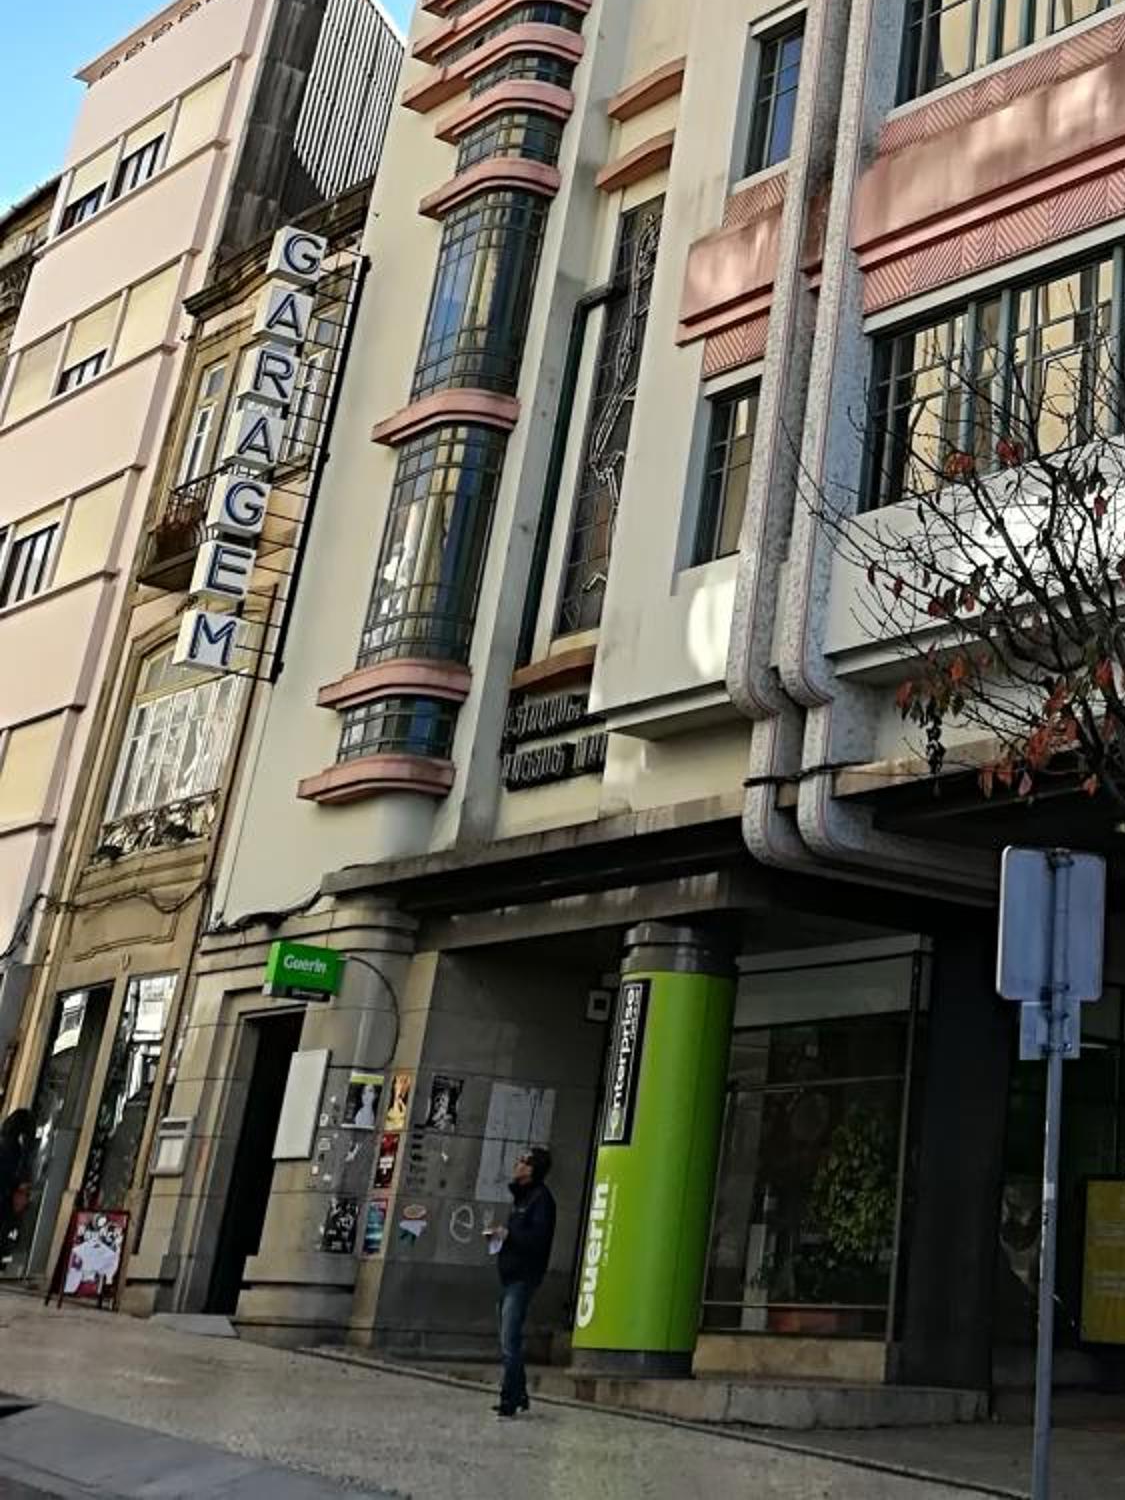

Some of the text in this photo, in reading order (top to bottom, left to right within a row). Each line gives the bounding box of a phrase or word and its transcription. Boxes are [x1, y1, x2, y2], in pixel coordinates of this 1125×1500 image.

[188, 234, 322, 669] GARAGEM
[283, 953, 327, 974] Guerin
[610, 988, 636, 1139] enterprise
[576, 1182, 609, 1329] Guerin
